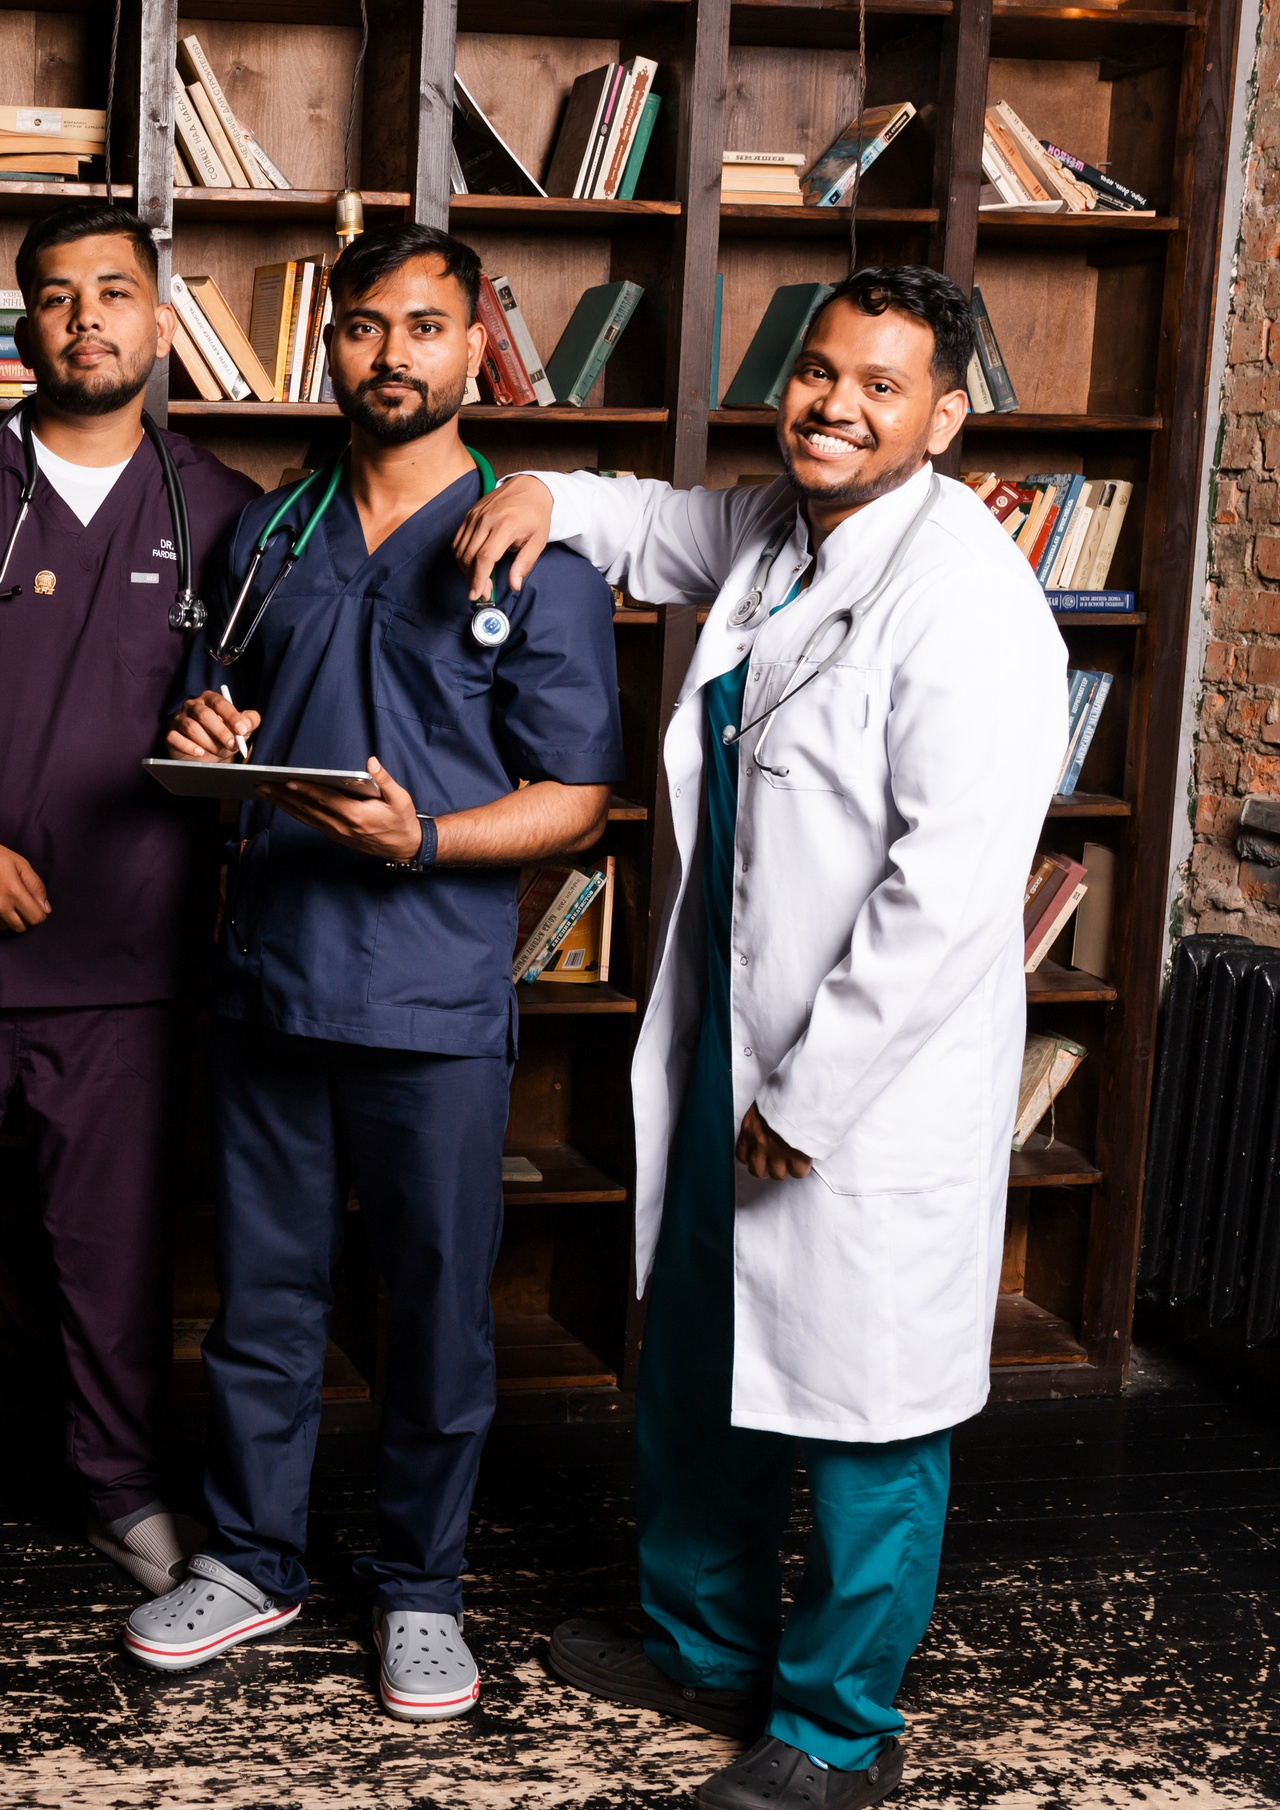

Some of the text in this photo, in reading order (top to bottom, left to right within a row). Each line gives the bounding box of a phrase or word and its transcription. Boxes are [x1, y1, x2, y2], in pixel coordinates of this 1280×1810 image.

[191, 43, 221, 97] СТРОИТЕЛЕЙ
[216, 97, 231, 115] ДЛЯ
[188, 125, 202, 145] НАД
[225, 115, 249, 159] ЧЕРЧЕНИЕ
[197, 146, 218, 180] СОЛНЦЕ
[735, 154, 785, 162] ЯМАШЕВ
[1047, 143, 1086, 173] ШЕЛДОН
[1099, 173, 1114, 186] ночь
[1113, 180, 1130, 198] день,
[1129, 190, 1148, 206] Утро,
[612, 289, 638, 325] БАЛЬЗАК
[160, 538, 175, 550] DR.
[152, 549, 178, 561] FARDEE
